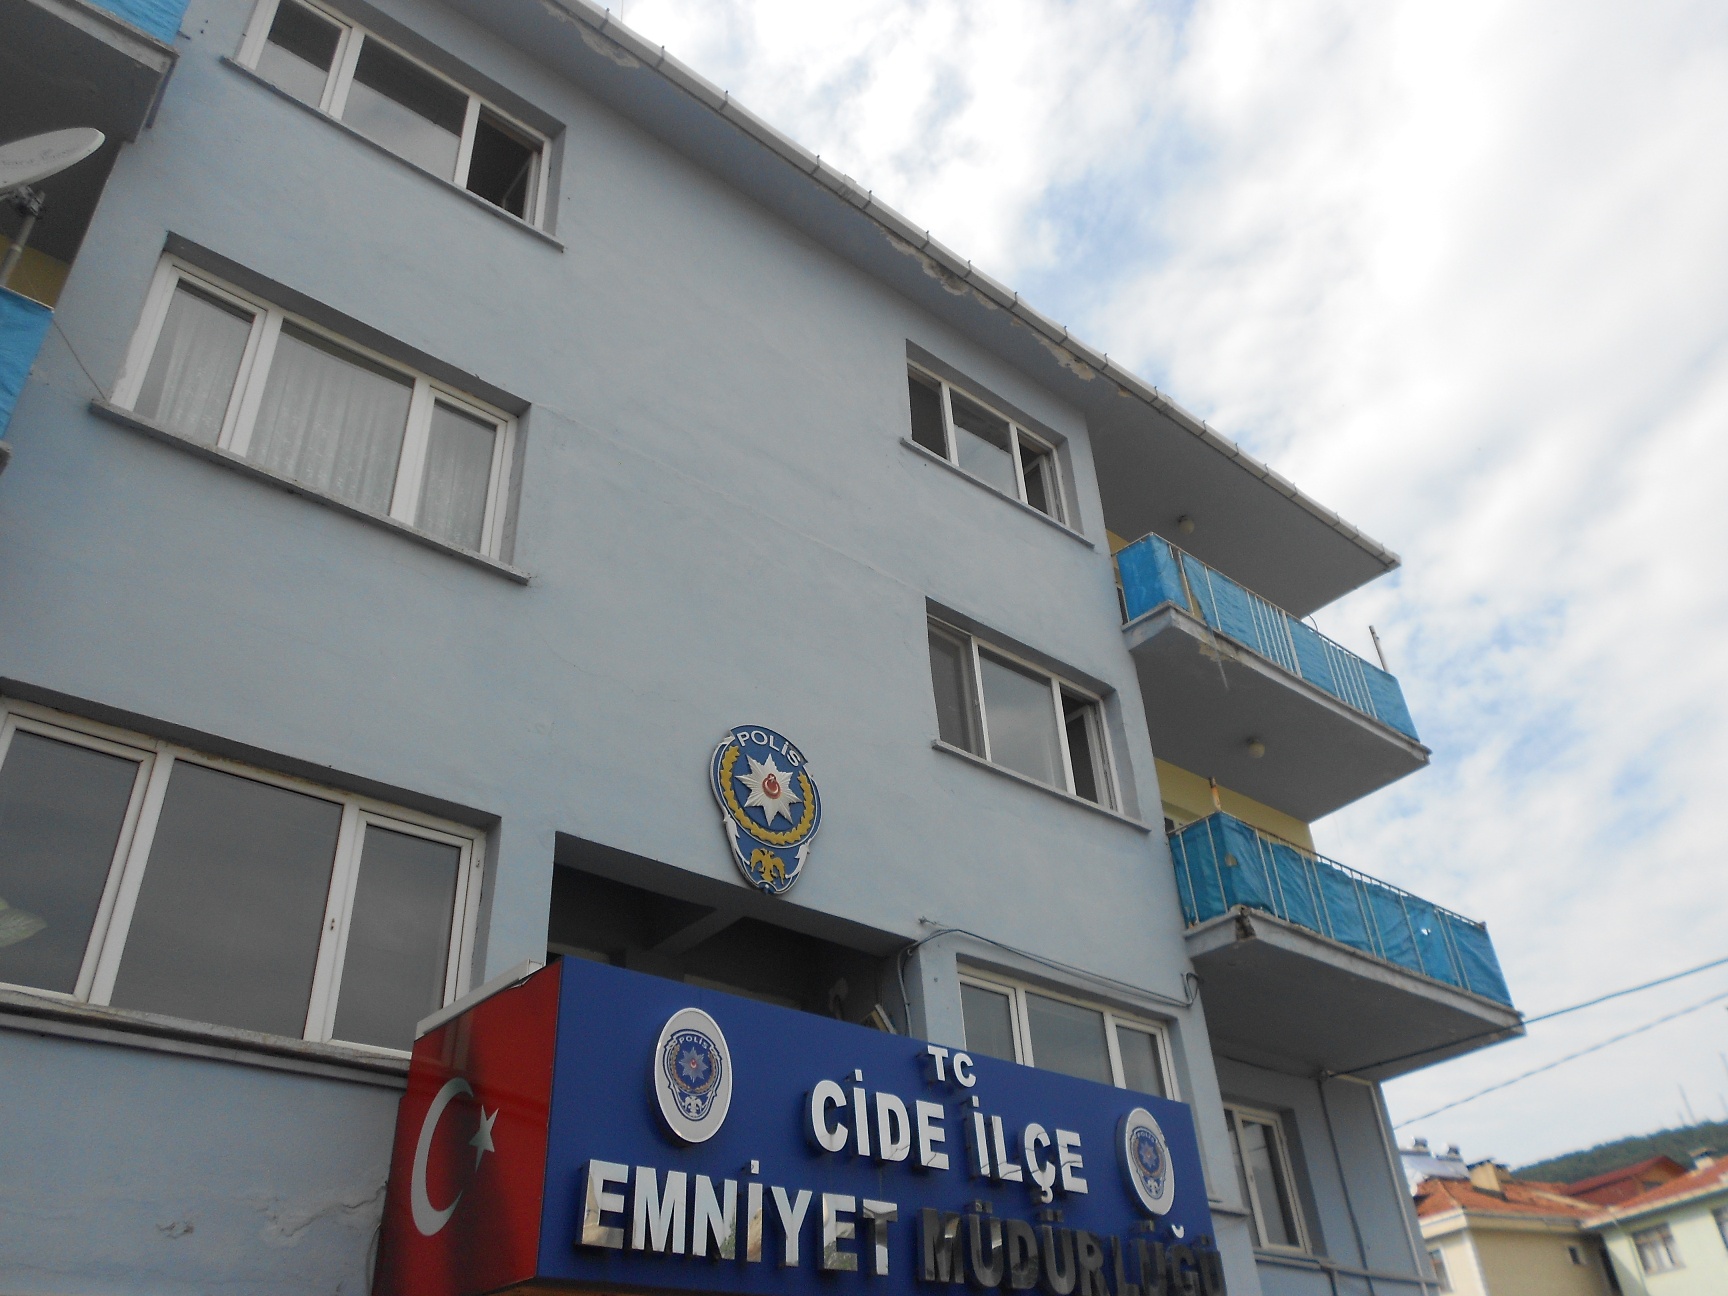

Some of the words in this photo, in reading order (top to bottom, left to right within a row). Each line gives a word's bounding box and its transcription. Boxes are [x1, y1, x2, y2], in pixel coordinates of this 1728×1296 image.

[926, 1044, 977, 1088] TC
[810, 1068, 949, 1171] CİDE
[972, 1095, 1089, 1204] İLÇE
[580, 1159, 898, 1276] EMNİYET
